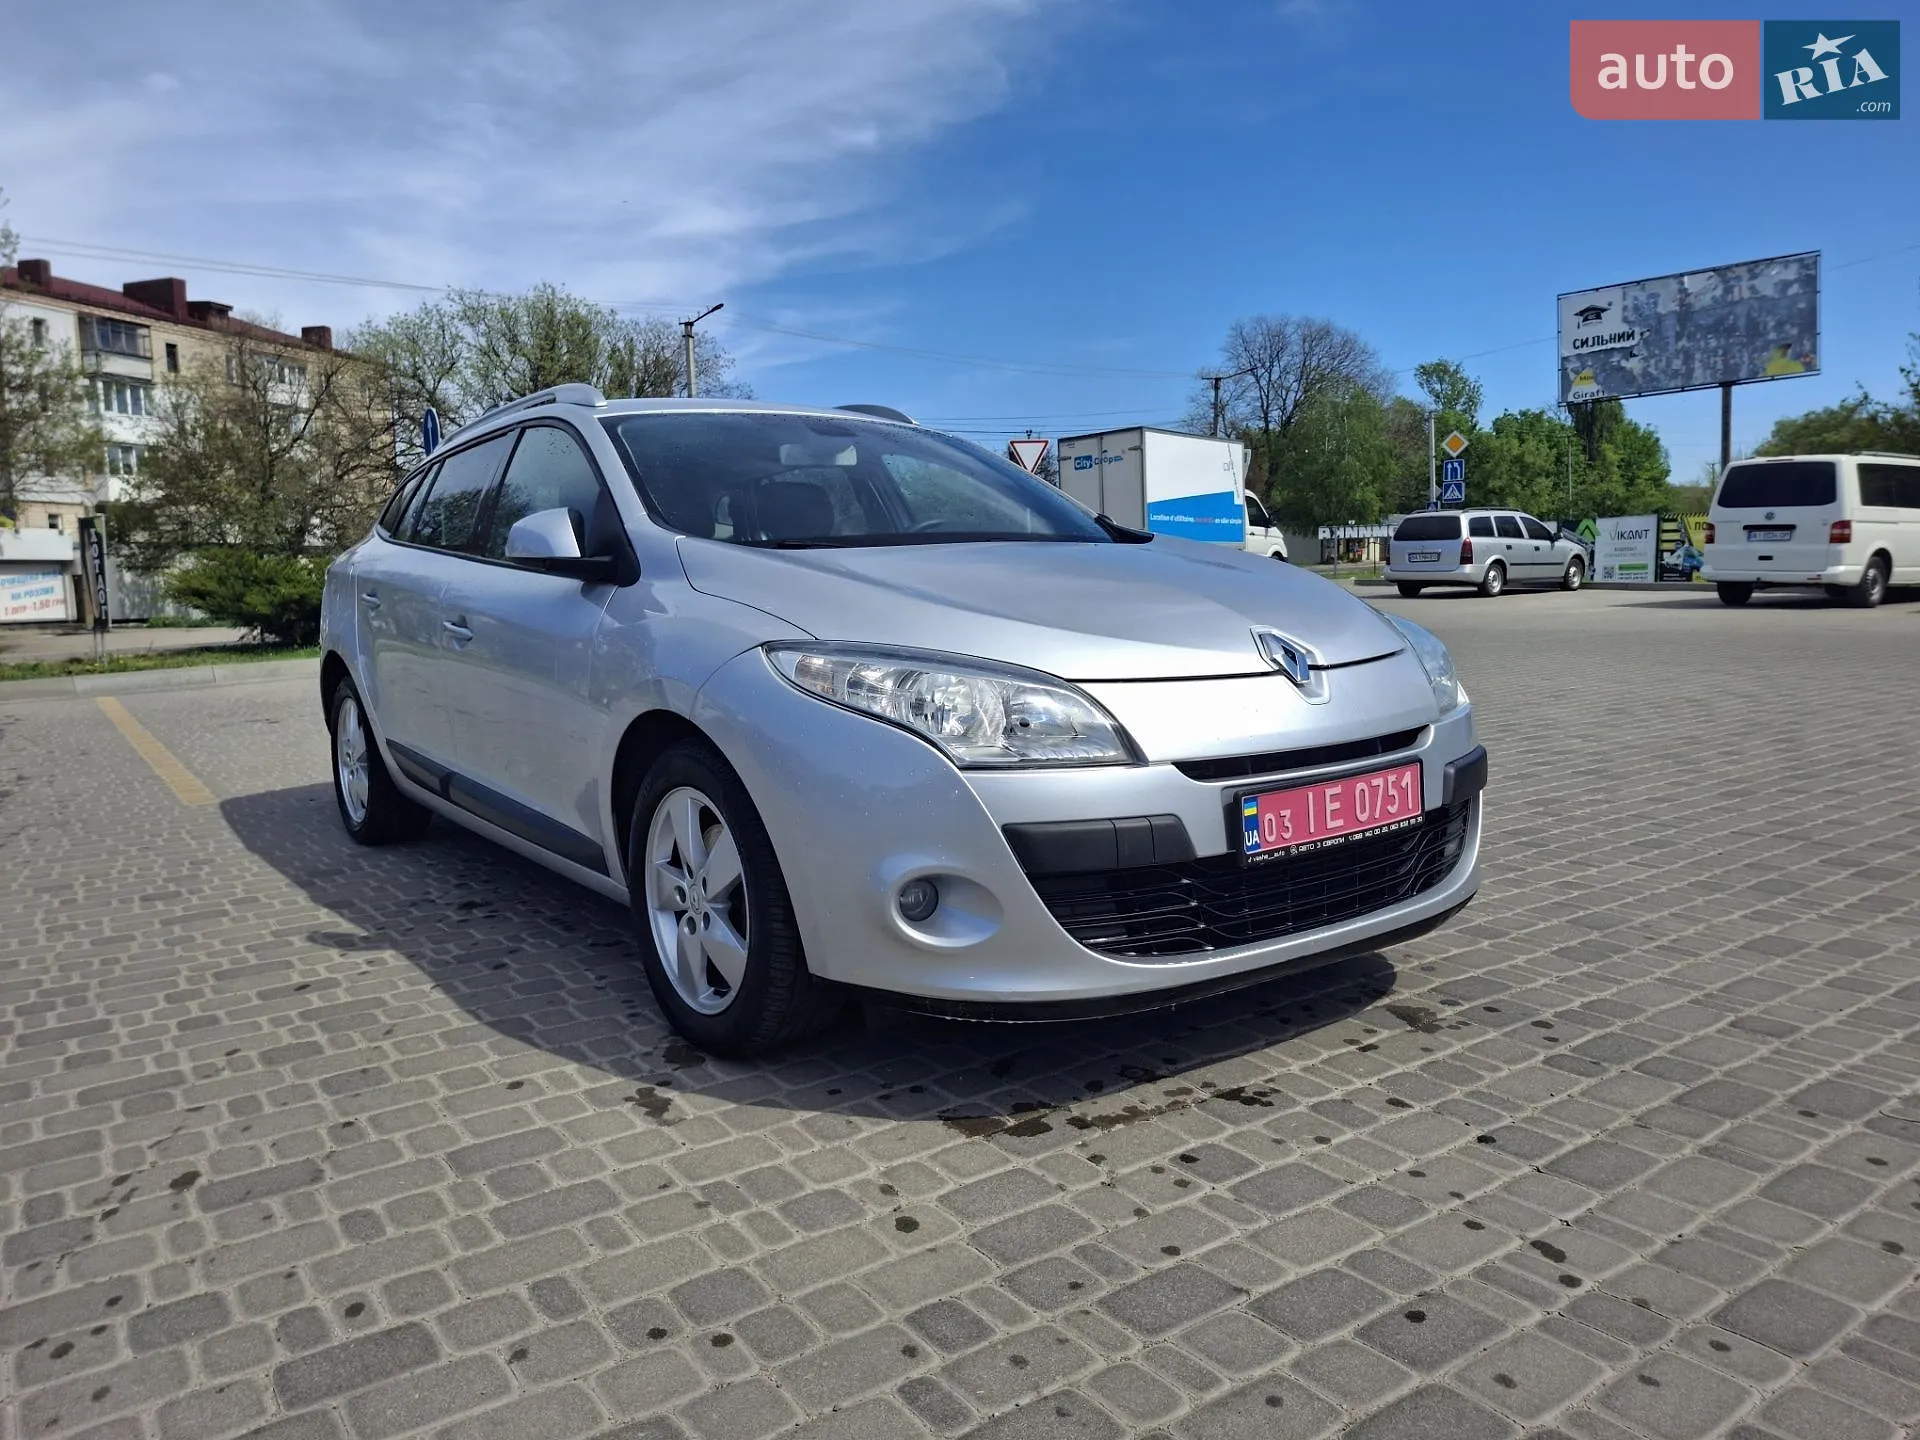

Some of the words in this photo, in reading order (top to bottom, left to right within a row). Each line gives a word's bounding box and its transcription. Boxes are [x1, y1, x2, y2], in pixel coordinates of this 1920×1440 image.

[1573, 327, 1635, 350] СИЛЬНИЙ
[1609, 520, 1650, 541] VIKANT
[1263, 809, 1293, 843] 03
[1307, 784, 1344, 834] IE
[1355, 770, 1414, 823] 0751
[1244, 830, 1260, 846] UA
